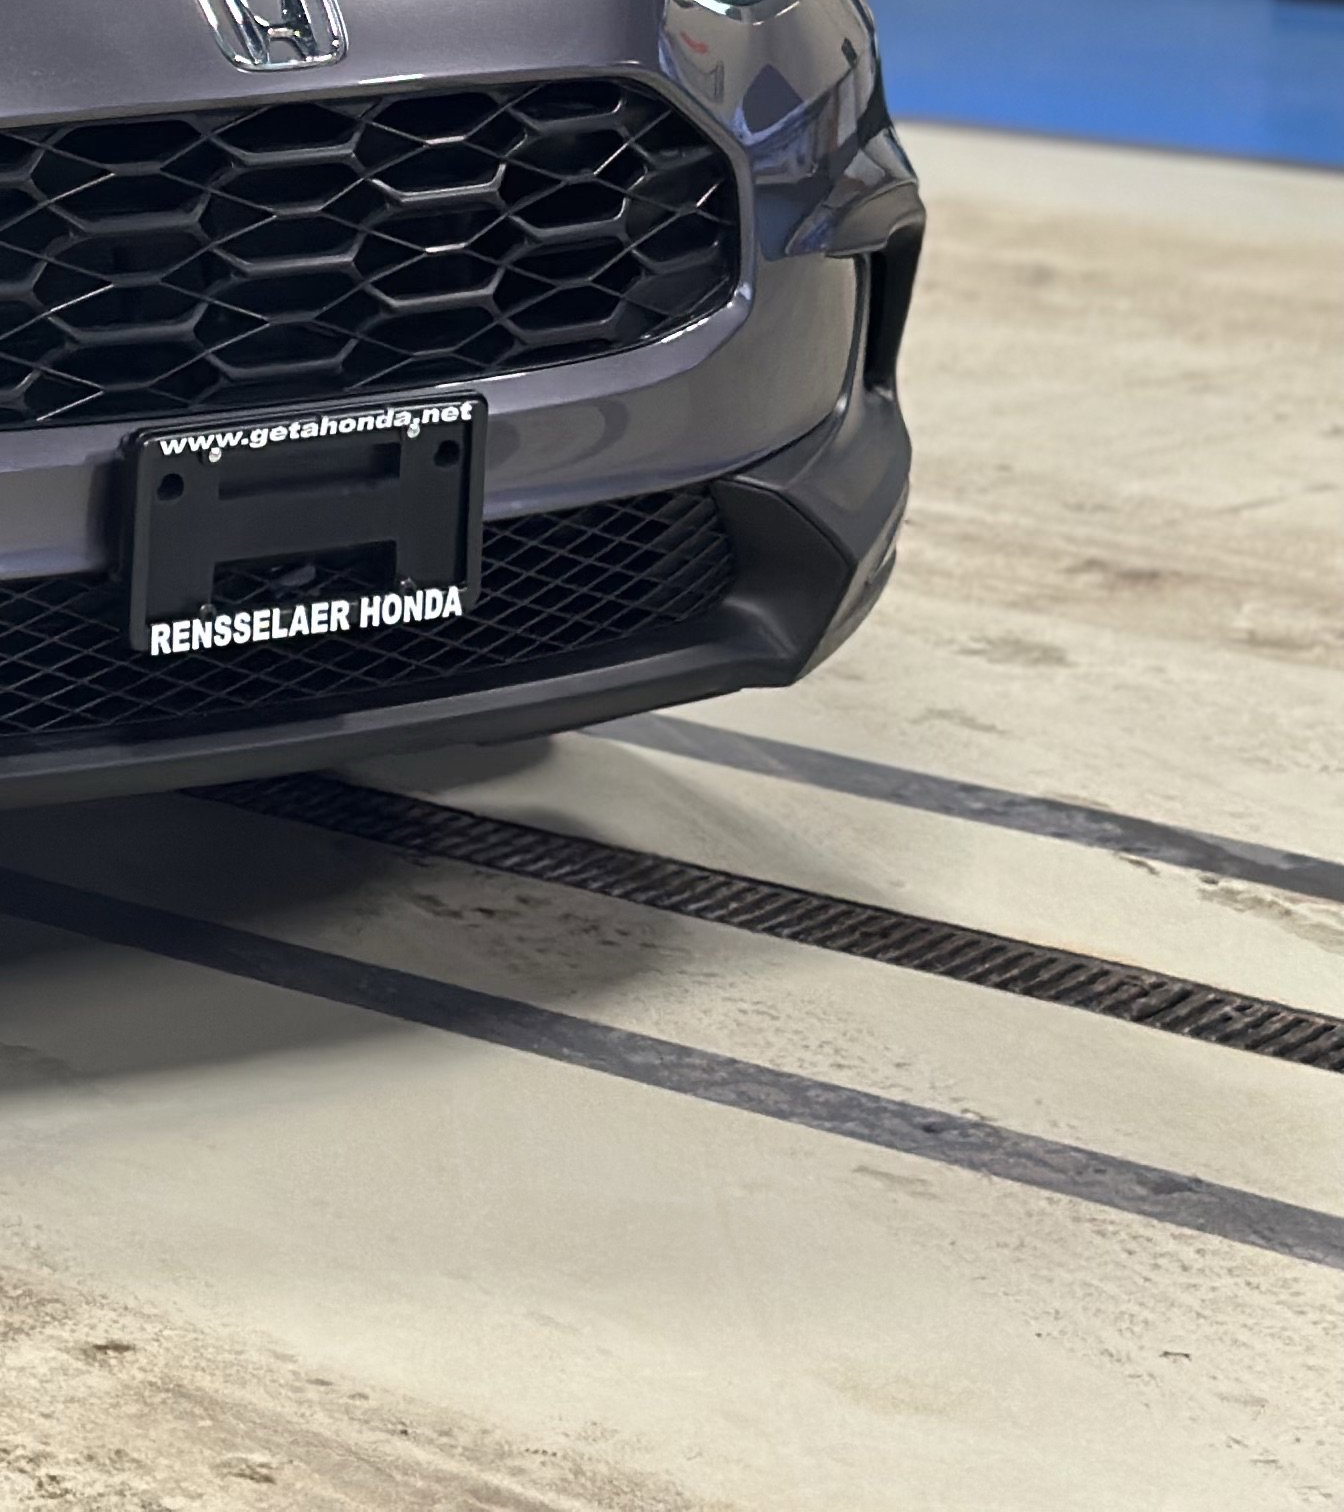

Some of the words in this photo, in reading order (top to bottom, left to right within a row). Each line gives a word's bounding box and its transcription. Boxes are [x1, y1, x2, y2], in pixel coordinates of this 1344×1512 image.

[159, 400, 474, 456] www.getahonda.net
[150, 599, 350, 656] RENSSELAER
[359, 585, 463, 628] HONDA
